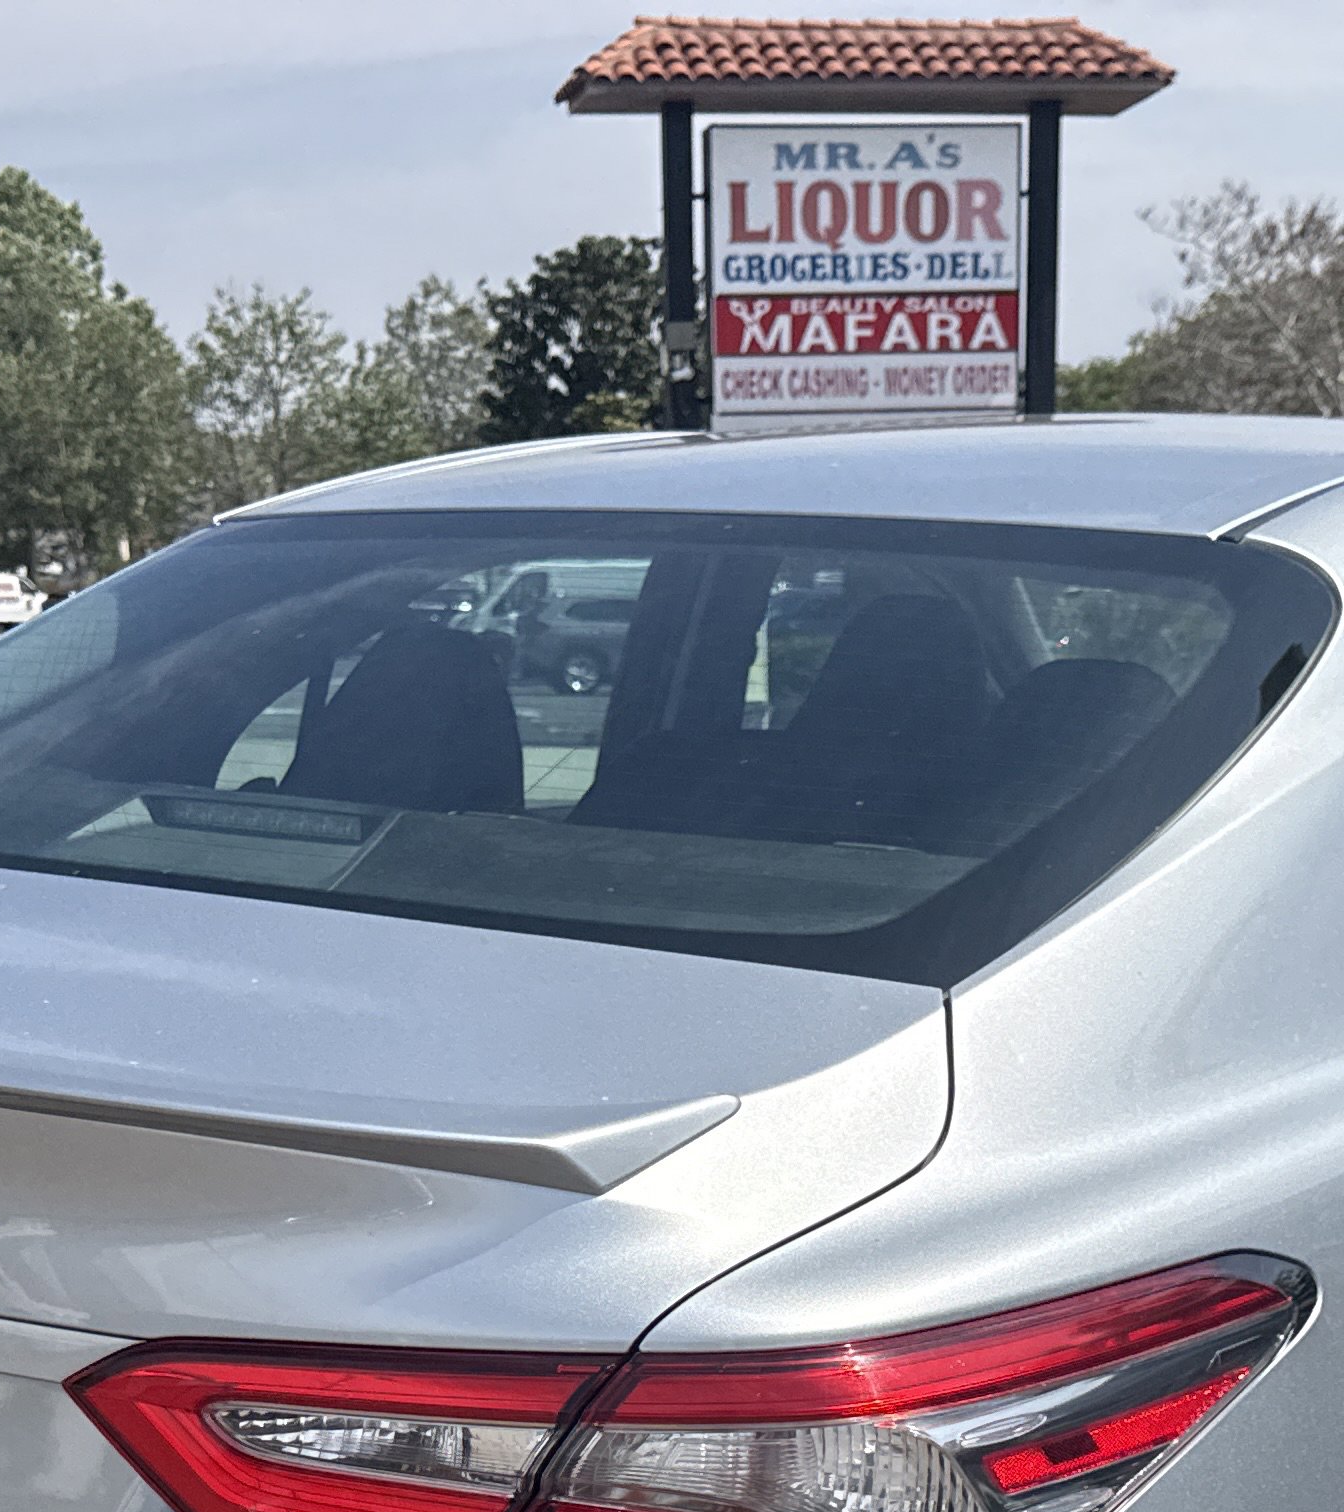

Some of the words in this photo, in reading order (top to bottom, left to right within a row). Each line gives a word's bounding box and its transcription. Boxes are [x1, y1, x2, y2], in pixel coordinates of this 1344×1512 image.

[773, 141, 877, 171] MR.
[727, 179, 1010, 251] LIQUOR
[790, 296, 899, 315] BEAUTY
[904, 294, 997, 314] SALON
[739, 312, 1008, 354] MAFARA
[721, 367, 785, 400] CHECK
[788, 366, 869, 399] CASHING
[884, 366, 949, 397] MONEY
[953, 364, 1010, 395] ORDER
